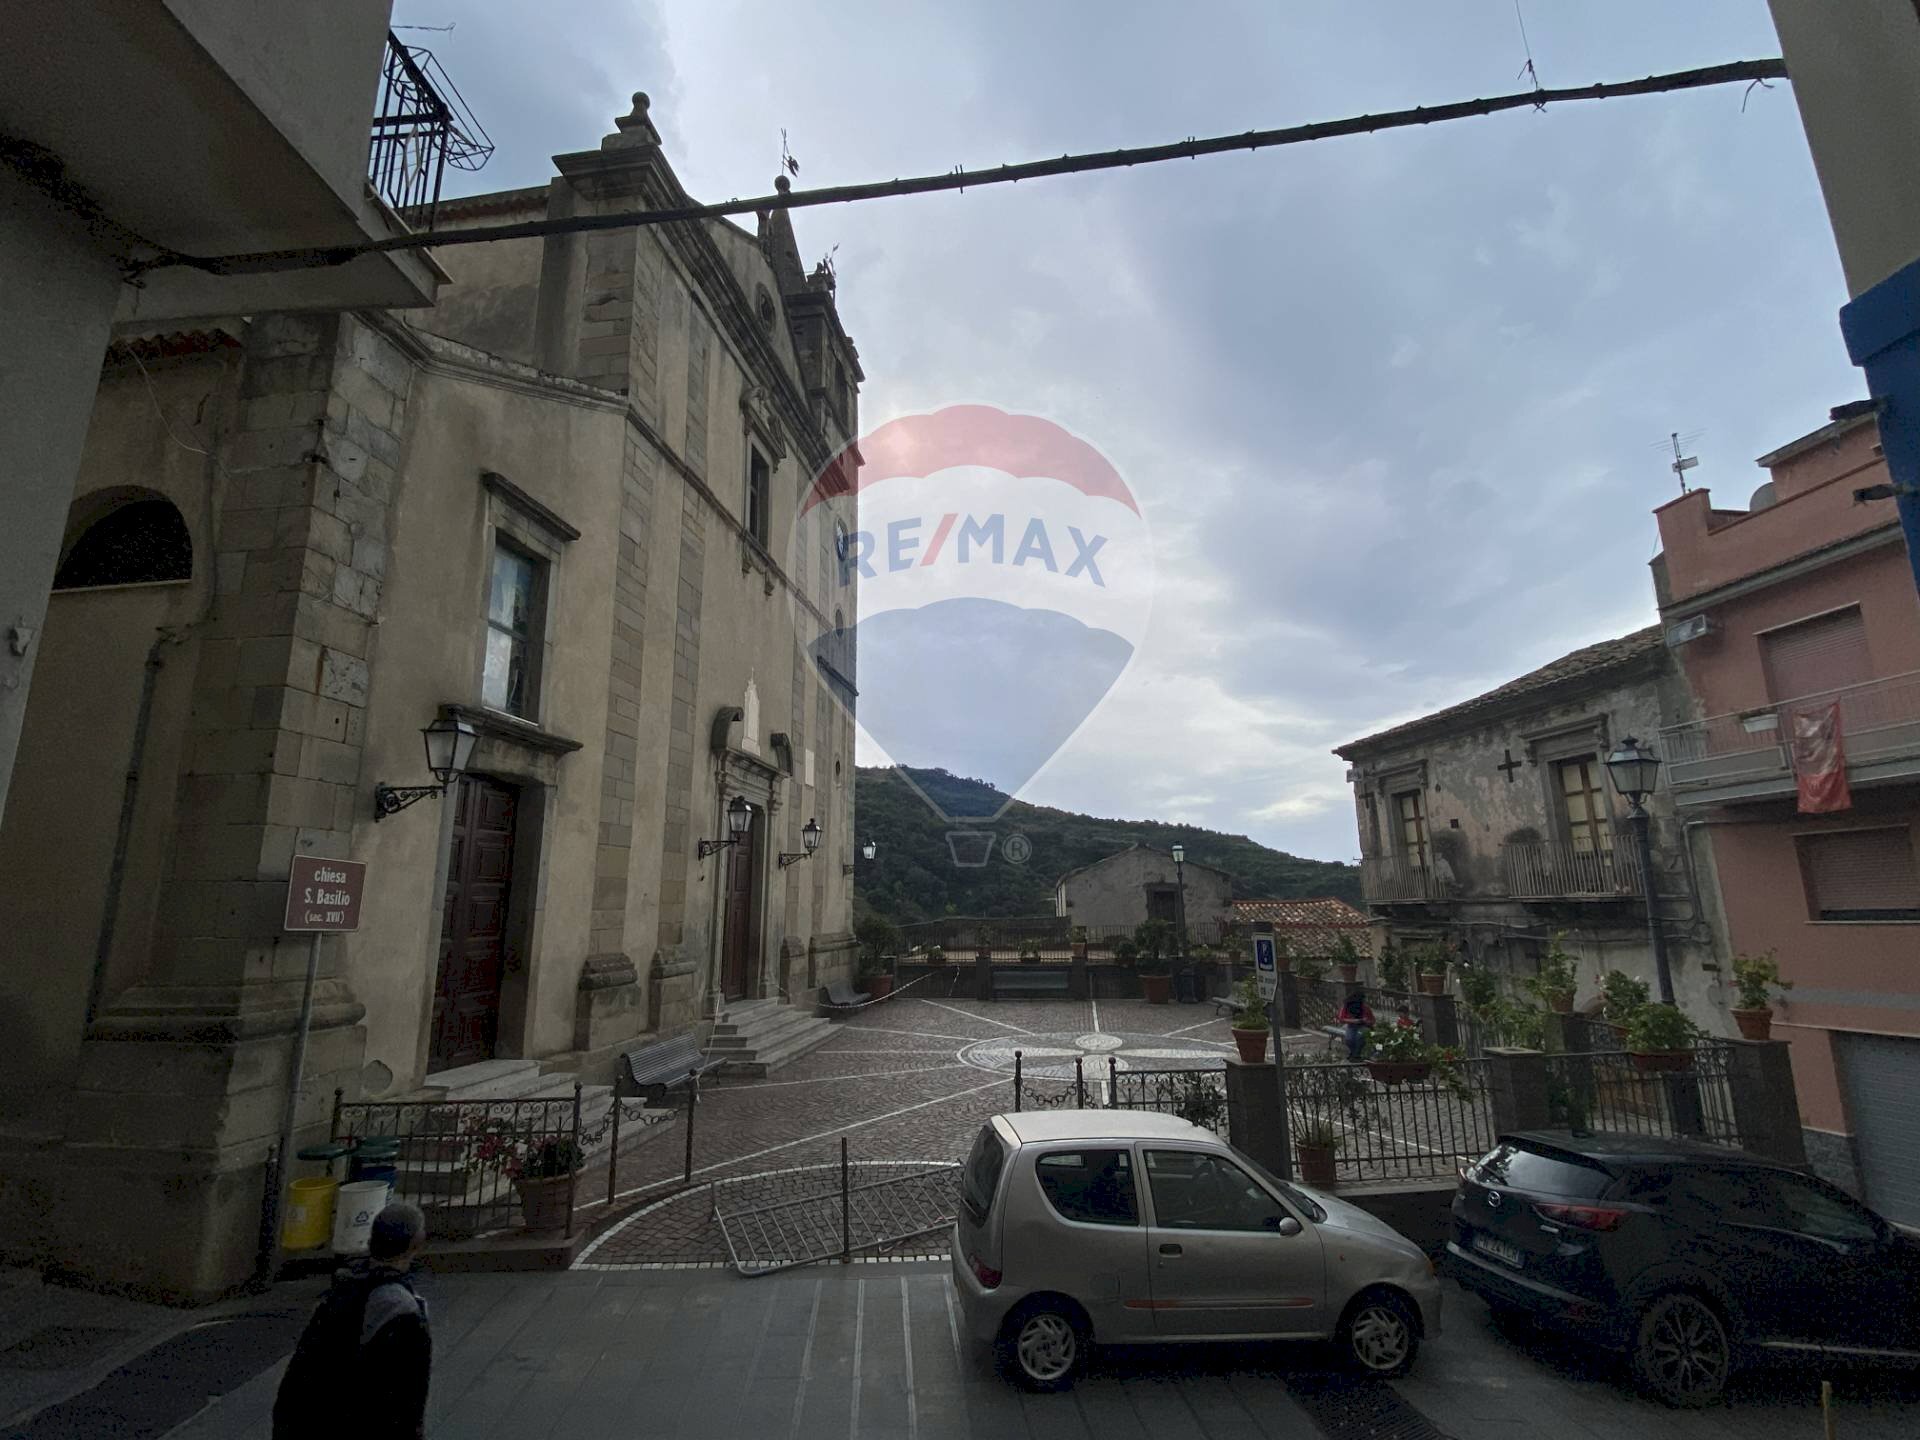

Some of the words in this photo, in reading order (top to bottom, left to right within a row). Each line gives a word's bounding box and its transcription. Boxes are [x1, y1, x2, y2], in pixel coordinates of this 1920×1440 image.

[314, 866, 347, 884] chiesa
[304, 887, 314, 904] S.
[316, 888, 351, 906] Basilio
[304, 910, 323, 925] (sec.
[325, 911, 345, 925] XVII)
